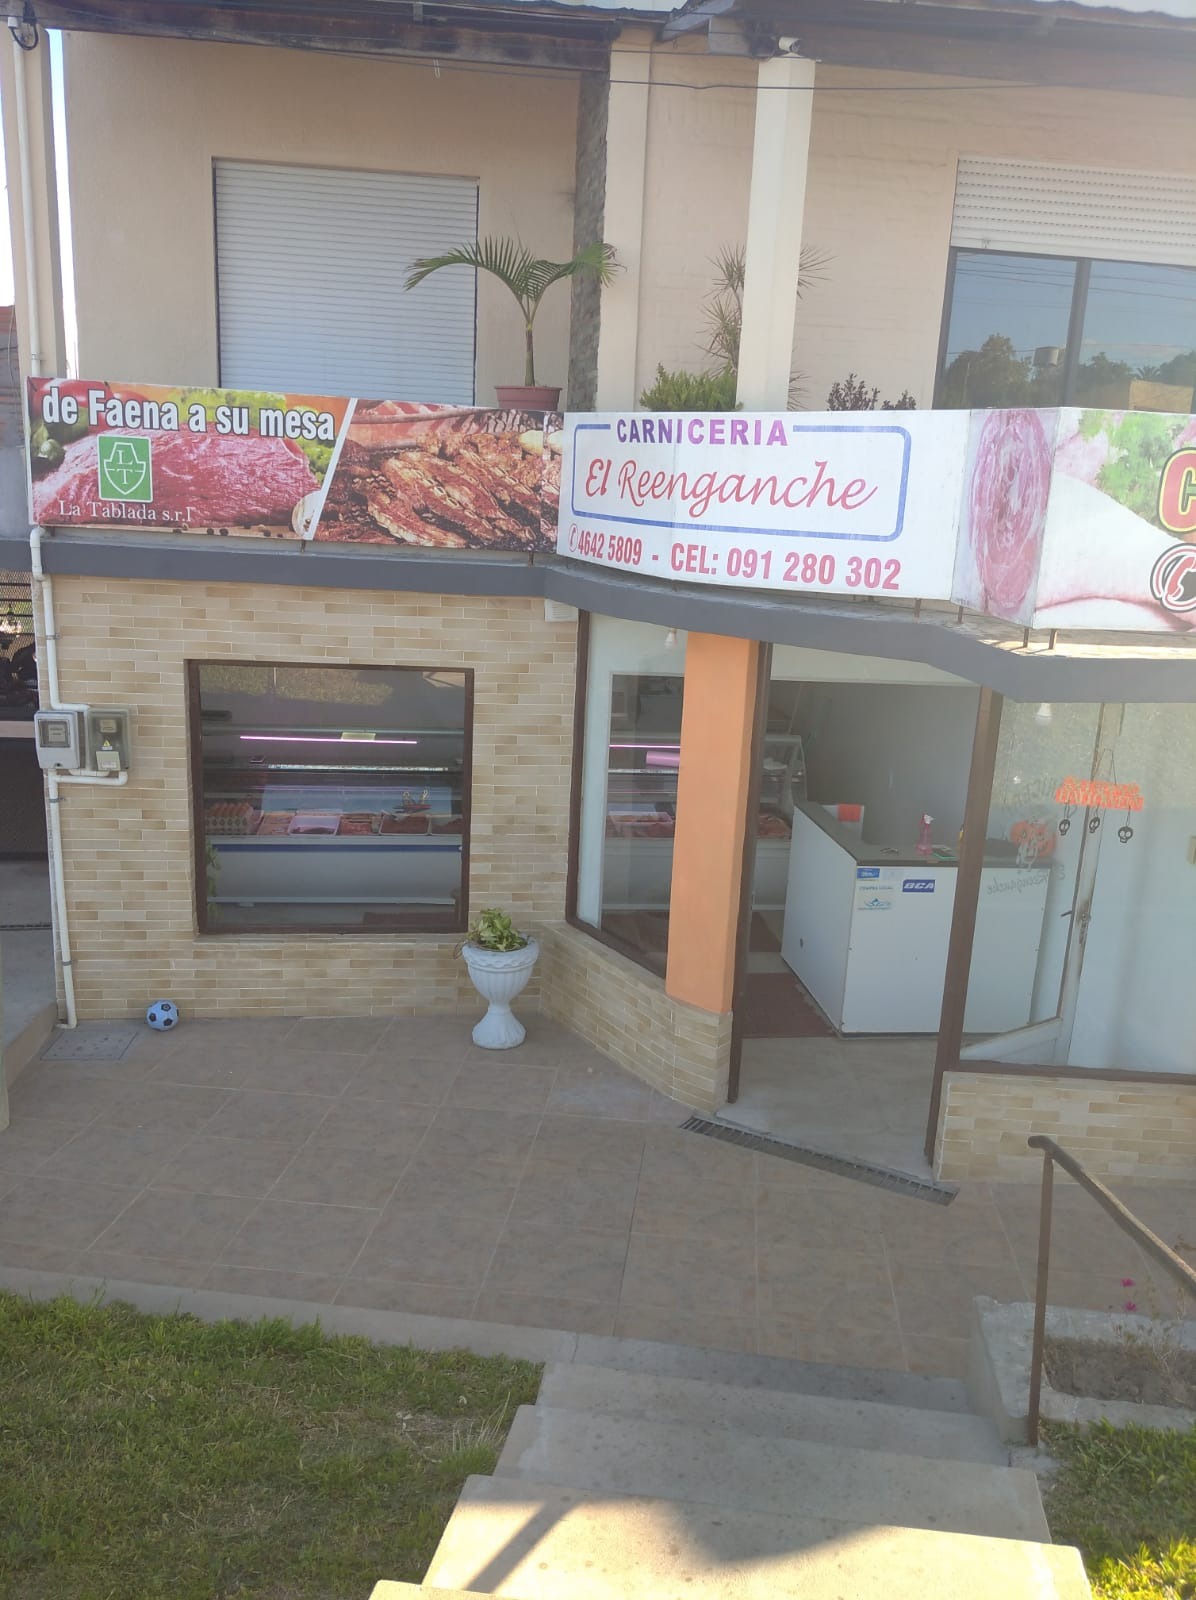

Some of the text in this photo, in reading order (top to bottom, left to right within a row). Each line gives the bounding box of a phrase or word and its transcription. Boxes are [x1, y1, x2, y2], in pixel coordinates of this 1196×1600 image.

[42, 386, 336, 441] de Faena a su mesa
[616, 418, 788, 446] CARNICERIA
[585, 458, 878, 518] El Reenganche
[59, 500, 81, 516] La
[86, 501, 157, 521] Tablada
[577, 531, 604, 558] 4642
[607, 535, 643, 566] 5809
[671, 542, 718, 575] CEL:
[726, 547, 772, 580] 091
[783, 551, 836, 585] 280
[845, 556, 902, 590] 302
[903, 882, 935, 890] BCA
